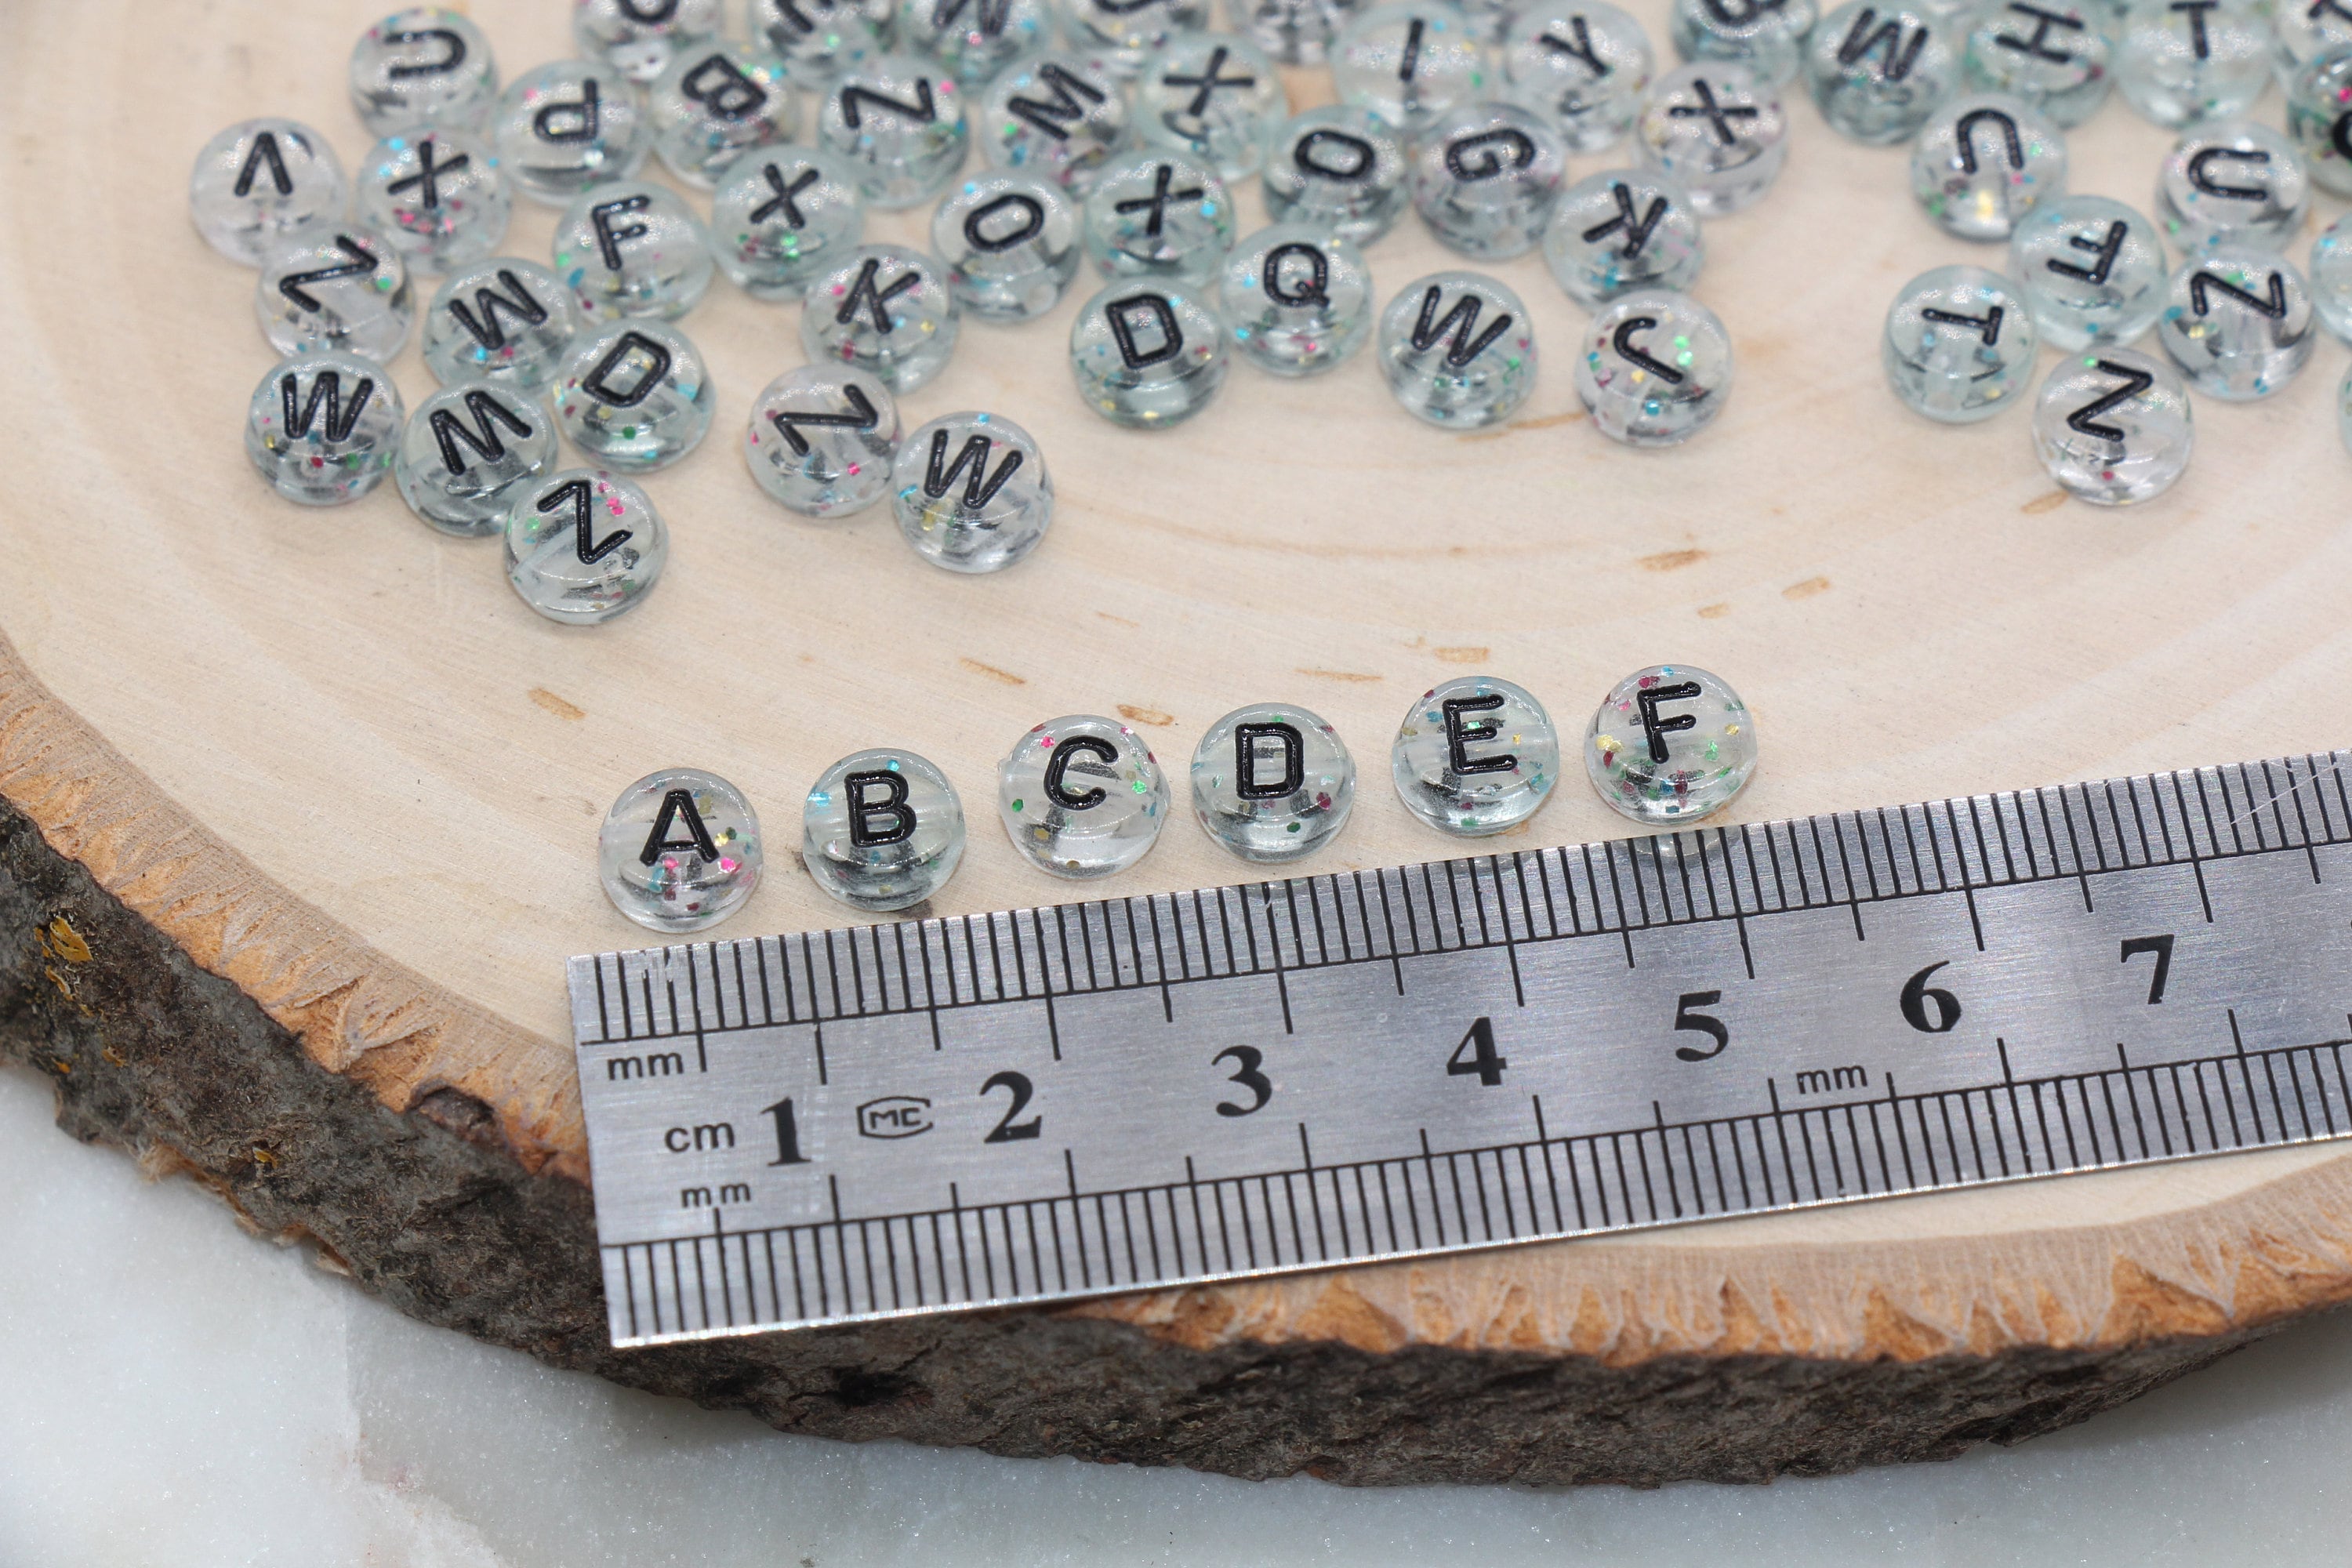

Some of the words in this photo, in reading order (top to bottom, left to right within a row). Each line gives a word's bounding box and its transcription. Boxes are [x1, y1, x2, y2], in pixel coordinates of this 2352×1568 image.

[1540, 17, 1608, 76] Y
[681, 53, 769, 121] B
[1163, 47, 1254, 117] X
[1669, 78, 1759, 146] X
[387, 140, 469, 209] X
[1294, 129, 1376, 183] O
[750, 164, 819, 229] X
[964, 194, 1044, 252] O
[1114, 164, 1204, 238] X
[590, 194, 653, 271] F
[837, 259, 920, 335] K
[1263, 242, 1330, 310] Q
[1105, 292, 1183, 371] D
[1410, 285, 1512, 368] W
[582, 331, 671, 408] D
[2067, 360, 2153, 442] Z
[281, 370, 374, 443] W
[924, 429, 1023, 510] W
[639, 789, 720, 867] A
[844, 769, 917, 849] B
[1044, 735, 1119, 811] C
[1235, 721, 1305, 800] D
[1442, 694, 1518, 776] E
[1636, 681, 1701, 764] F
[607, 1051, 685, 1081] mm
[665, 1123, 735, 1152] cm
[759, 1096, 812, 1167] 1
[980, 1071, 1042, 1144] 2
[1211, 1045, 1272, 1117] 3
[1446, 1017, 1507, 1087] 4
[1674, 990, 1729, 1062] 5
[1900, 960, 1962, 1033] 6
[2121, 934, 2175, 1005] 7
[1796, 1065, 1868, 1094] mm
[682, 1184, 750, 1207] mm
